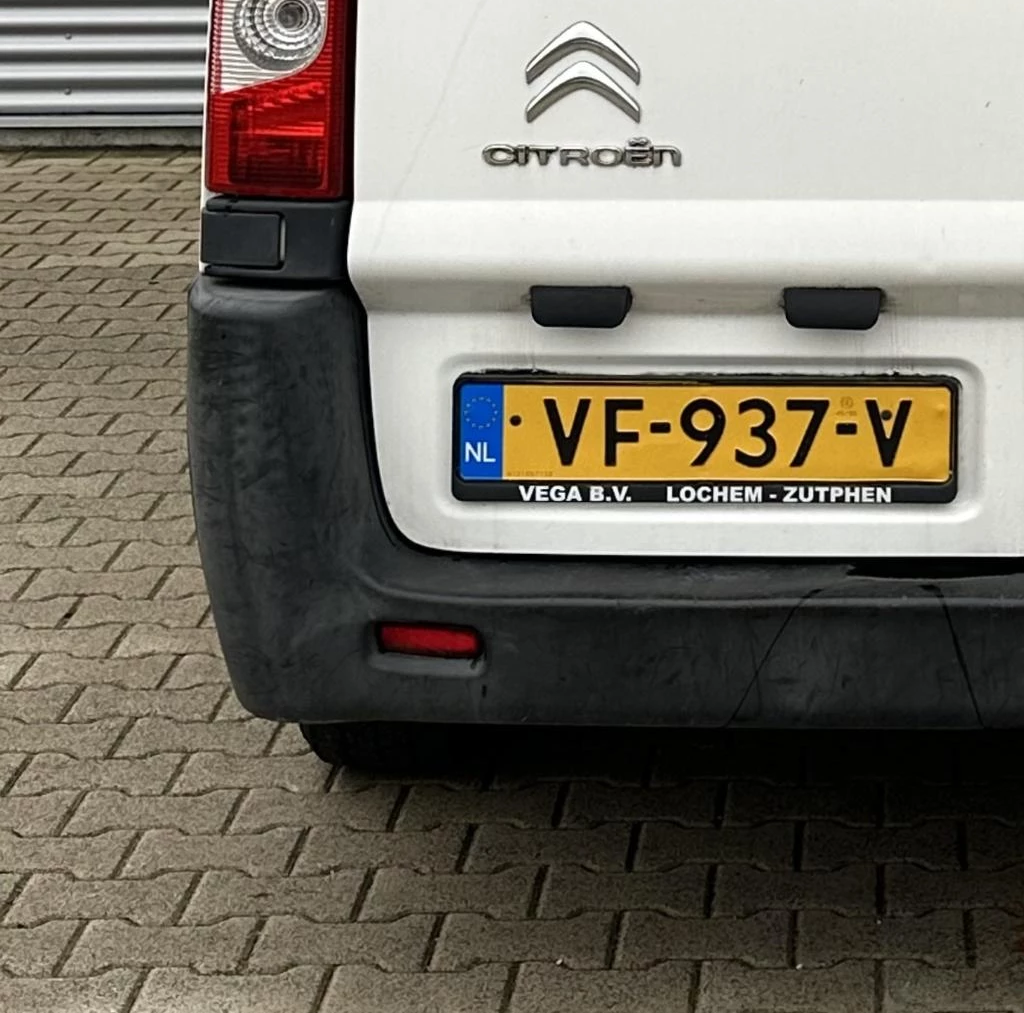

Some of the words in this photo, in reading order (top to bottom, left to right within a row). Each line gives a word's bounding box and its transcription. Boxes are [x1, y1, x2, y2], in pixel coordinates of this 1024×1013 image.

[543, 398, 913, 468] VF-937-V
[464, 441, 496, 464] NL
[518, 485, 583, 502] VEGA
[590, 486, 633, 503] B.V.
[666, 486, 763, 503] LOCHEM
[782, 486, 892, 504] ZUTPHEN
